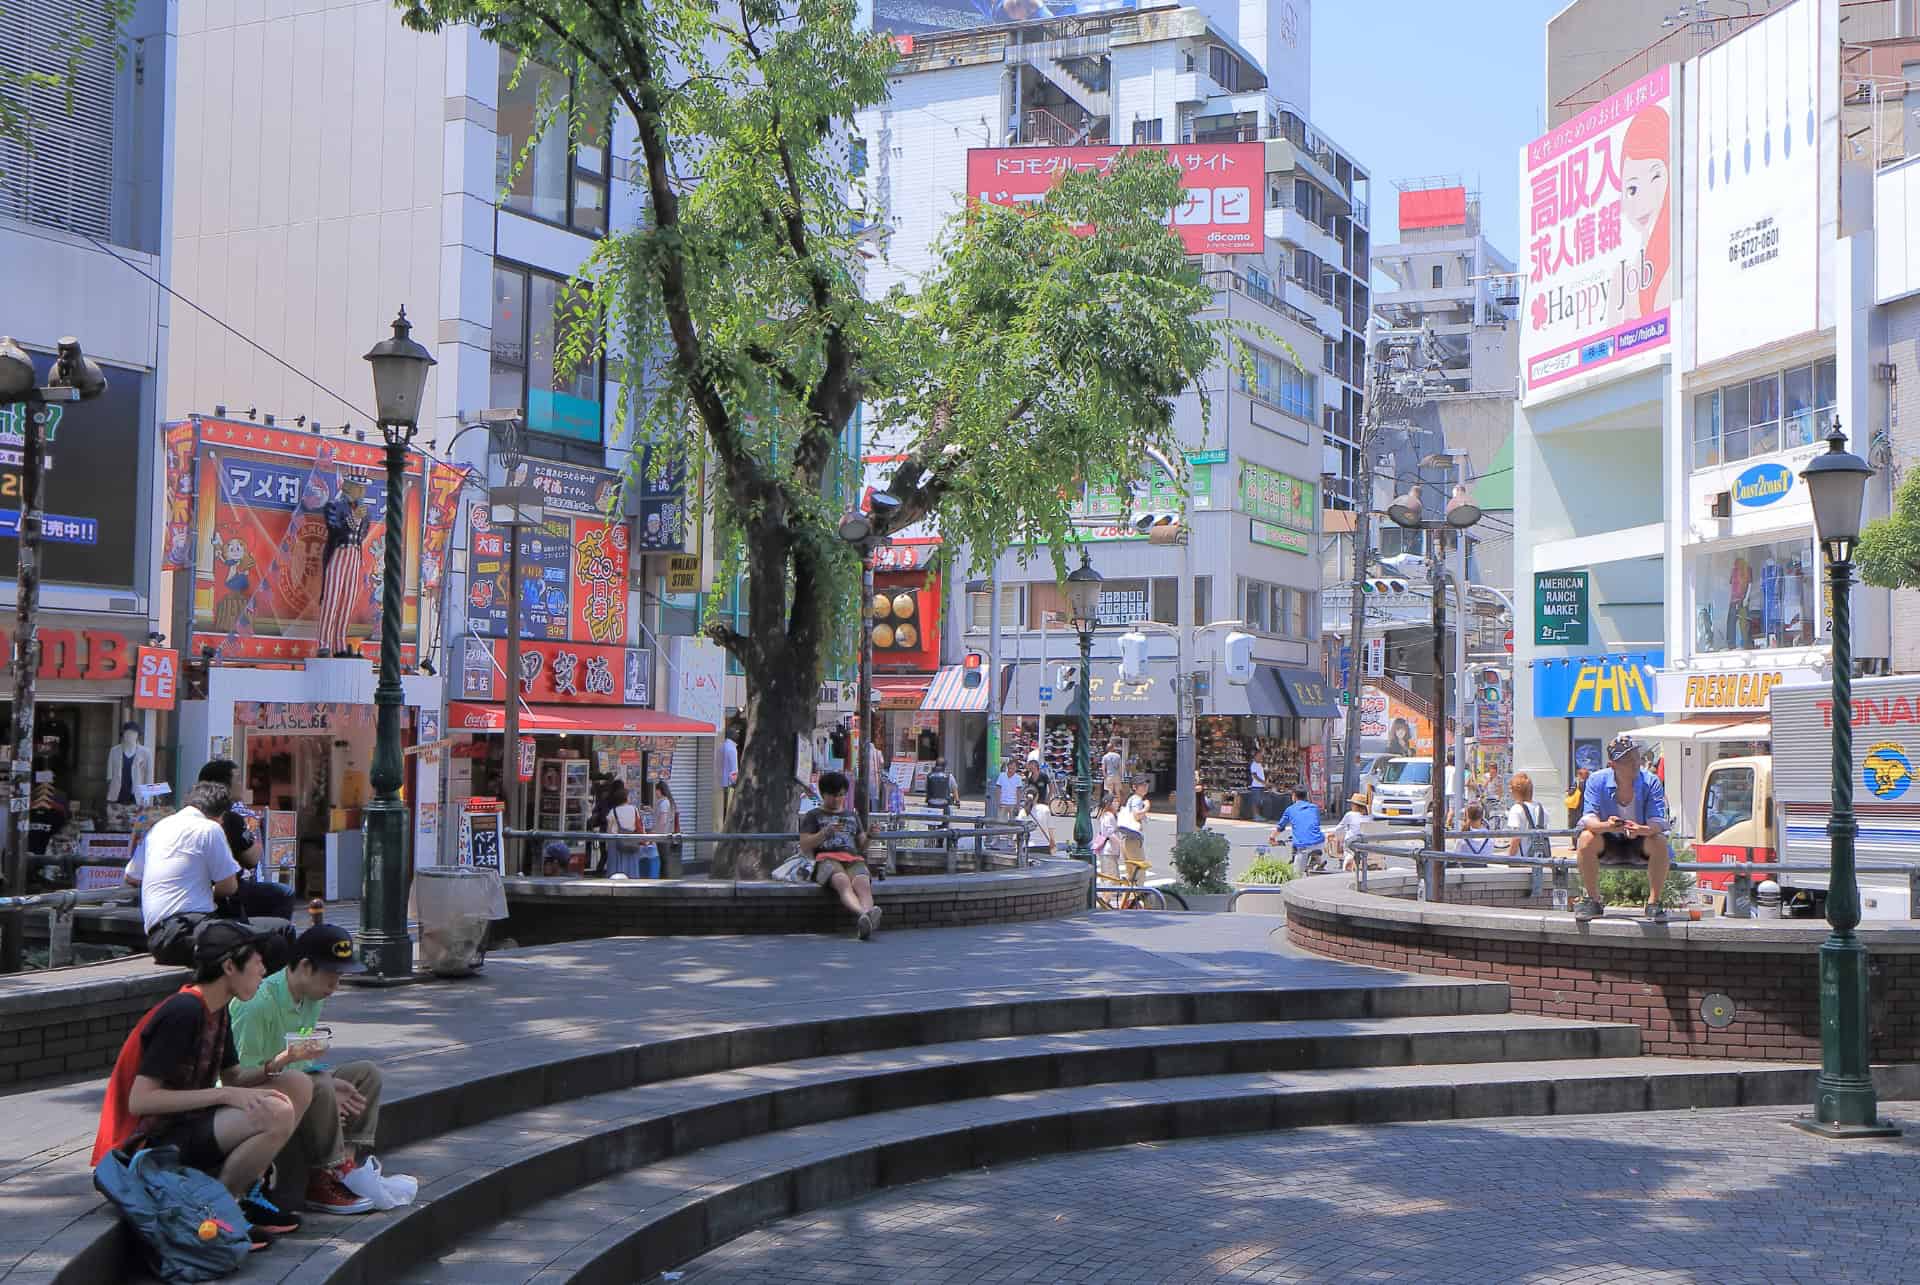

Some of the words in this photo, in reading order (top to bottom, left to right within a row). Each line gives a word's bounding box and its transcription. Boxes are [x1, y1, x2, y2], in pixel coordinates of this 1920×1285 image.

[1531, 135, 1623, 236] 高収入
[1207, 231, 1251, 241] docomo
[1530, 201, 1622, 285] 求人情報
[1548, 279, 1610, 329] Happy
[1617, 248, 1654, 310] Job
[229, 467, 301, 503] アメ村
[1539, 577, 1584, 589] AMERICAN
[1546, 591, 1576, 602] RANCH
[1543, 604, 1579, 616] MARKET
[1542, 625, 1553, 637] 2F
[519, 650, 615, 697] 甲賀流
[1567, 665, 1652, 713] FHM
[1684, 674, 1737, 708] FRESH
